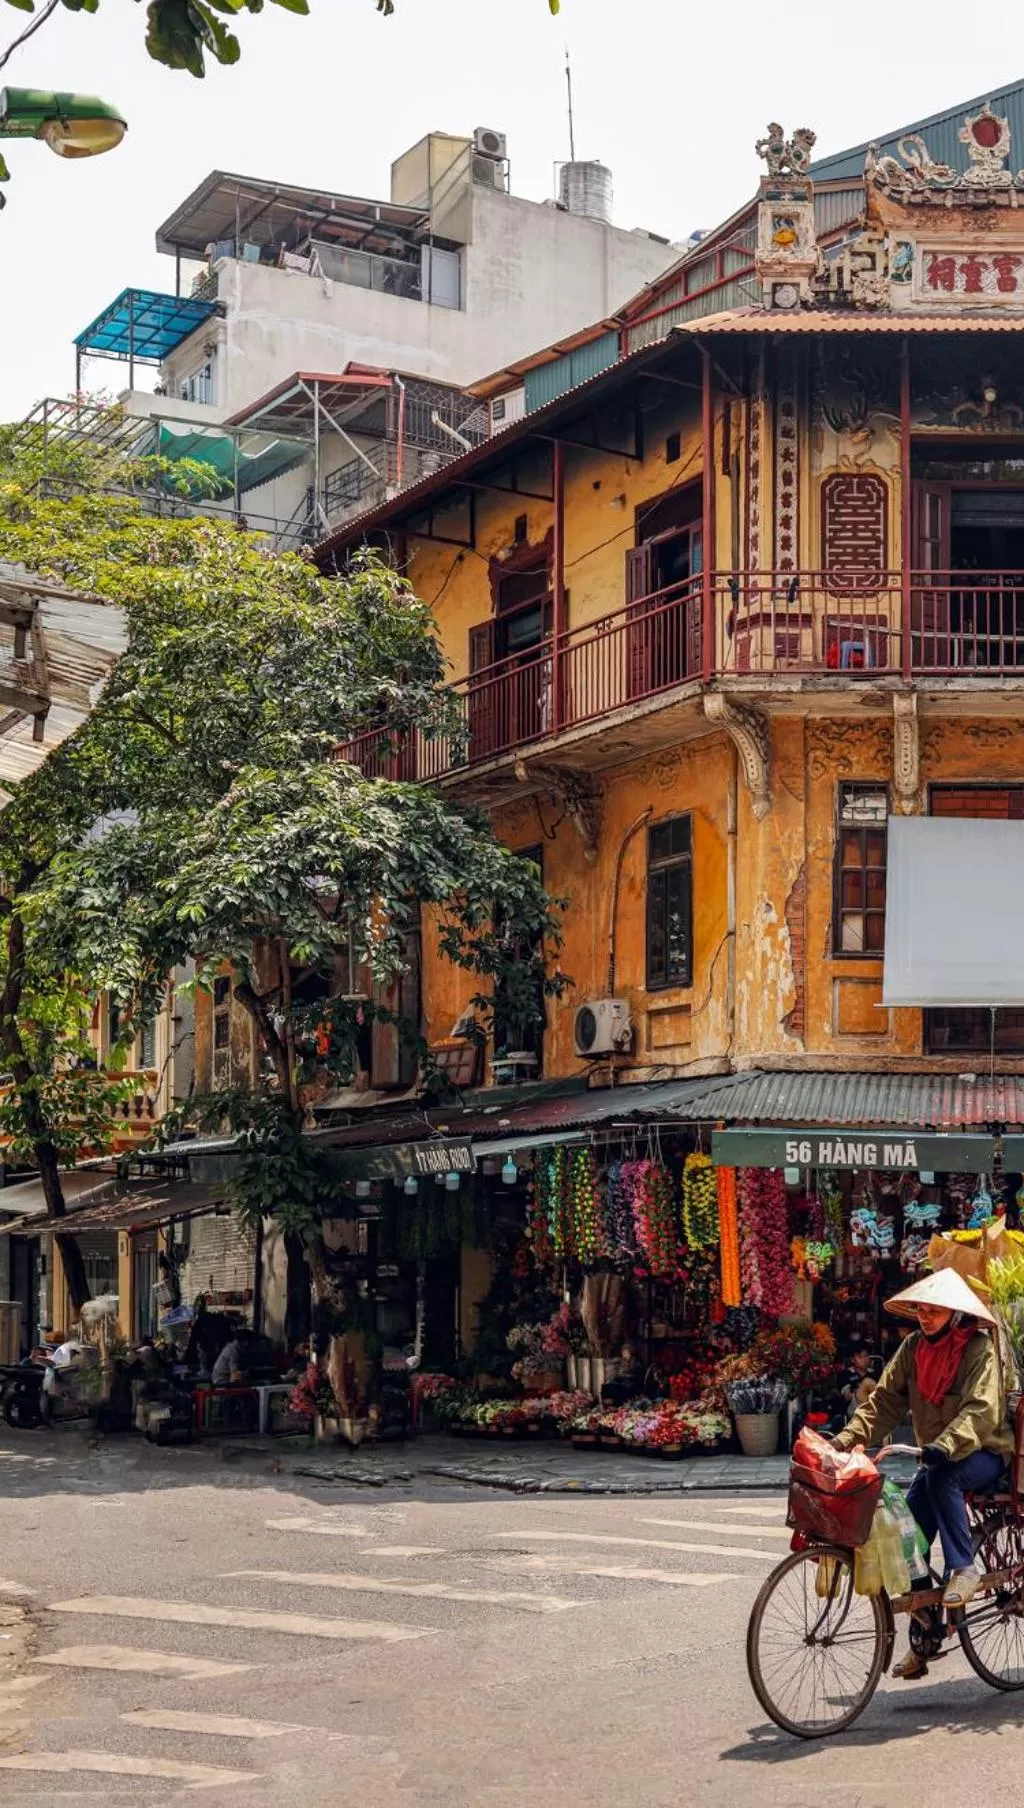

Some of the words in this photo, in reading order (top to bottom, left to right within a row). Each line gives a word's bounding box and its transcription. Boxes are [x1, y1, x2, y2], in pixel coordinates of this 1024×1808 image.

[785, 1140, 812, 1164] 56
[818, 1136, 878, 1166] HÀNG
[883, 1138, 919, 1168] MÃ
